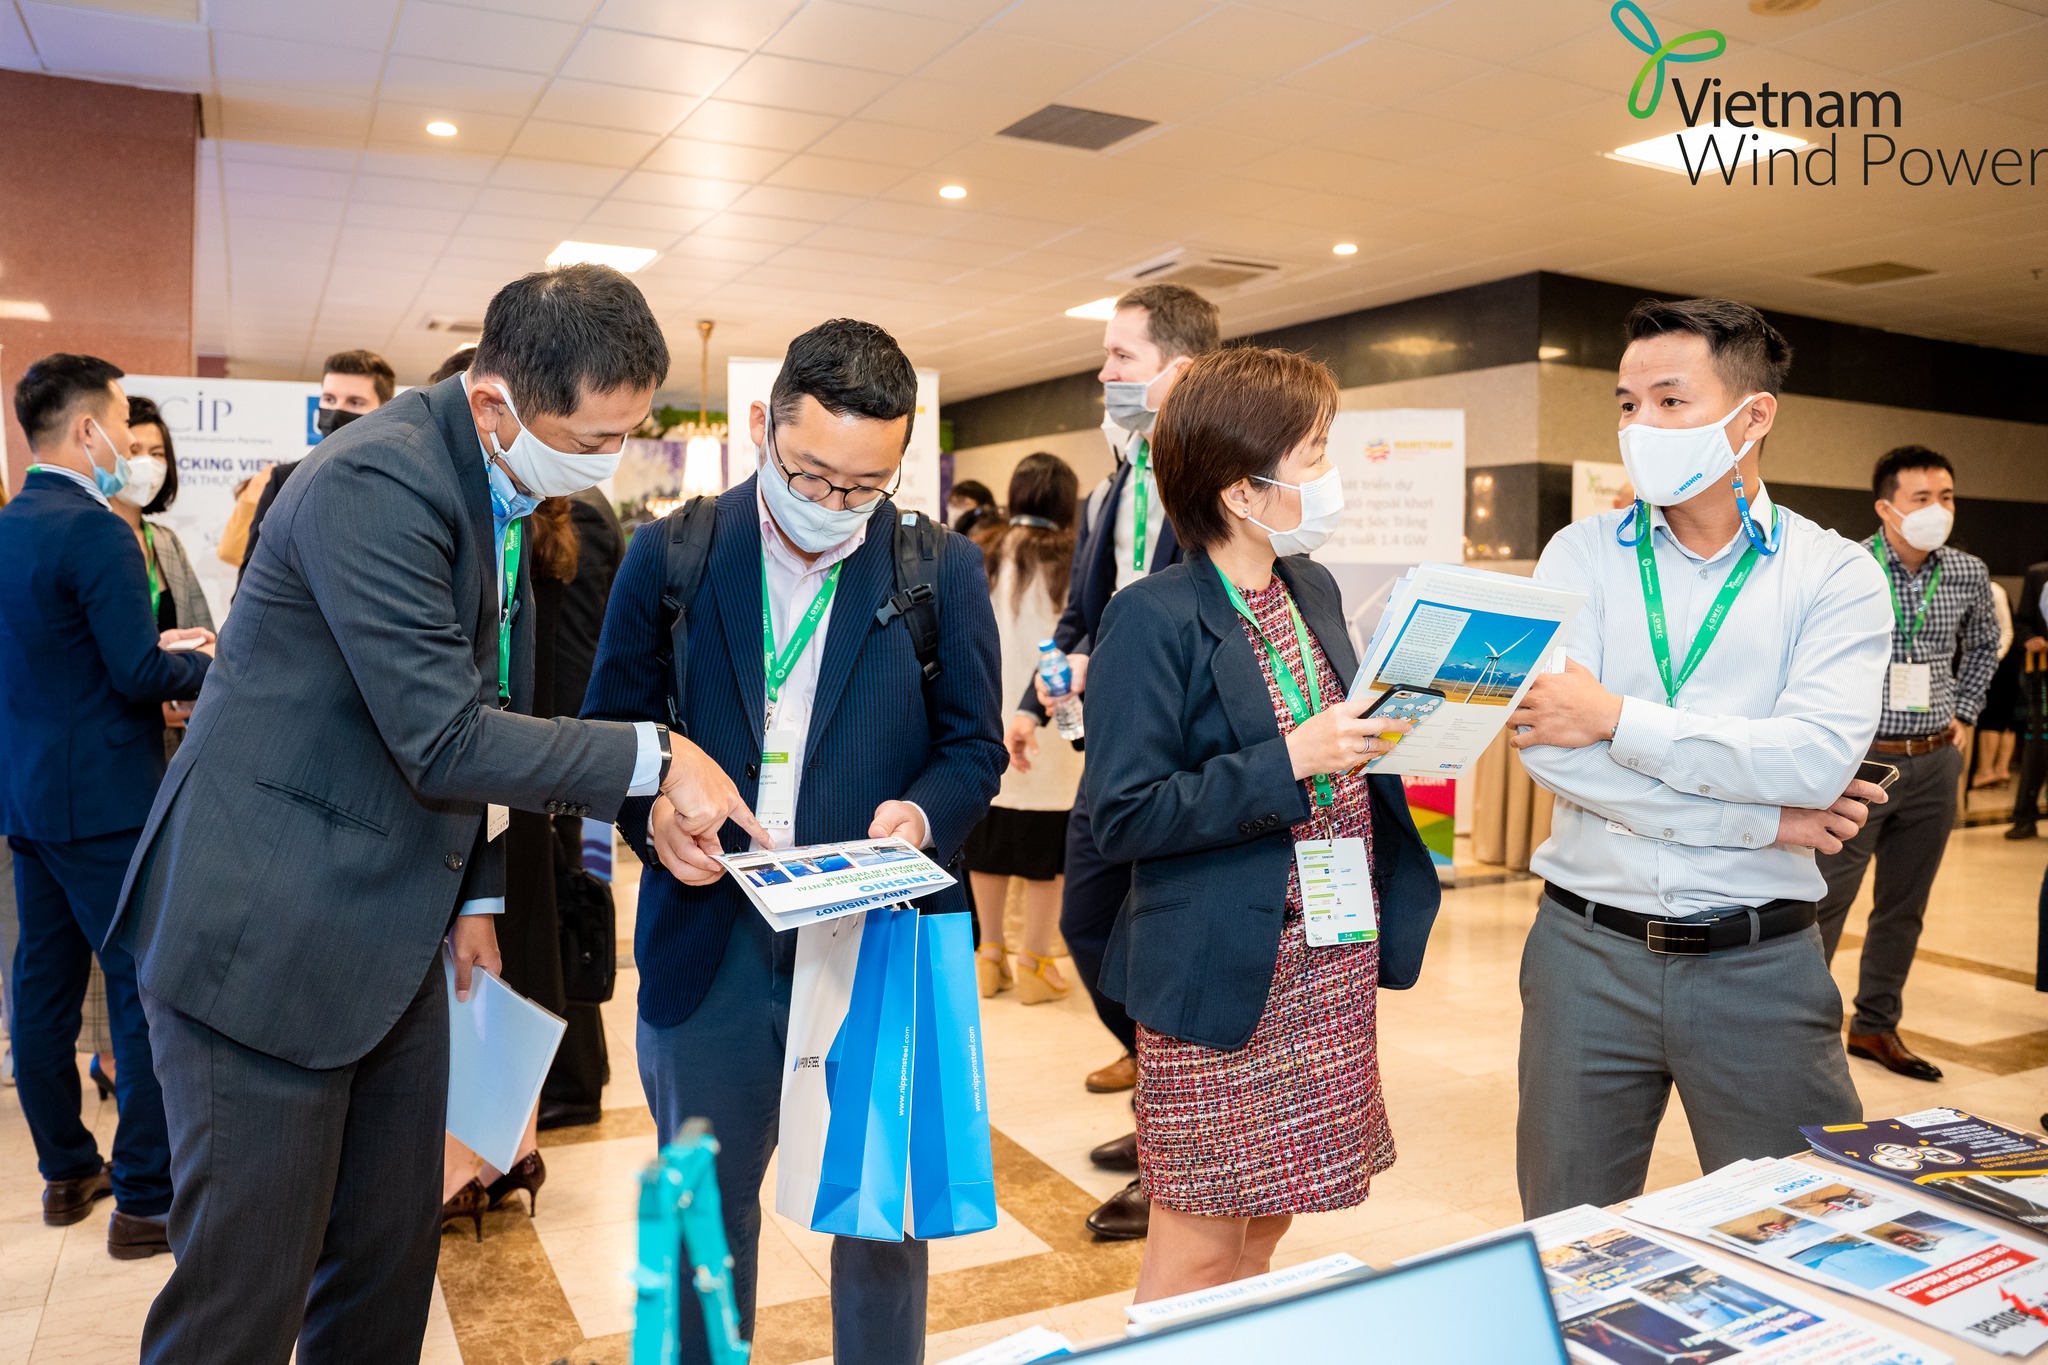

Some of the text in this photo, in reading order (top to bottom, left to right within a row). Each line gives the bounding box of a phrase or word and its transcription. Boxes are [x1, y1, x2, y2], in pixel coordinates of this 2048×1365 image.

[1678, 472, 1703, 493] NISHIO
[1743, 516, 1755, 538] NISHIO
[811, 596, 825, 615] GWEC
[1709, 604, 1724, 624] GWEC
[1655, 618, 1663, 639] GWEC
[1287, 692, 1301, 714] GWEC
[825, 869, 872, 882] VIETNAM
[859, 875, 929, 893] NISHIO
[794, 881, 834, 892] RENTAL
[815, 889, 912, 917] Why's NISHIO?
[899, 1026, 910, 1116] www.nipponsteel.com
[968, 1025, 981, 1112] www.nipponsteel.com
